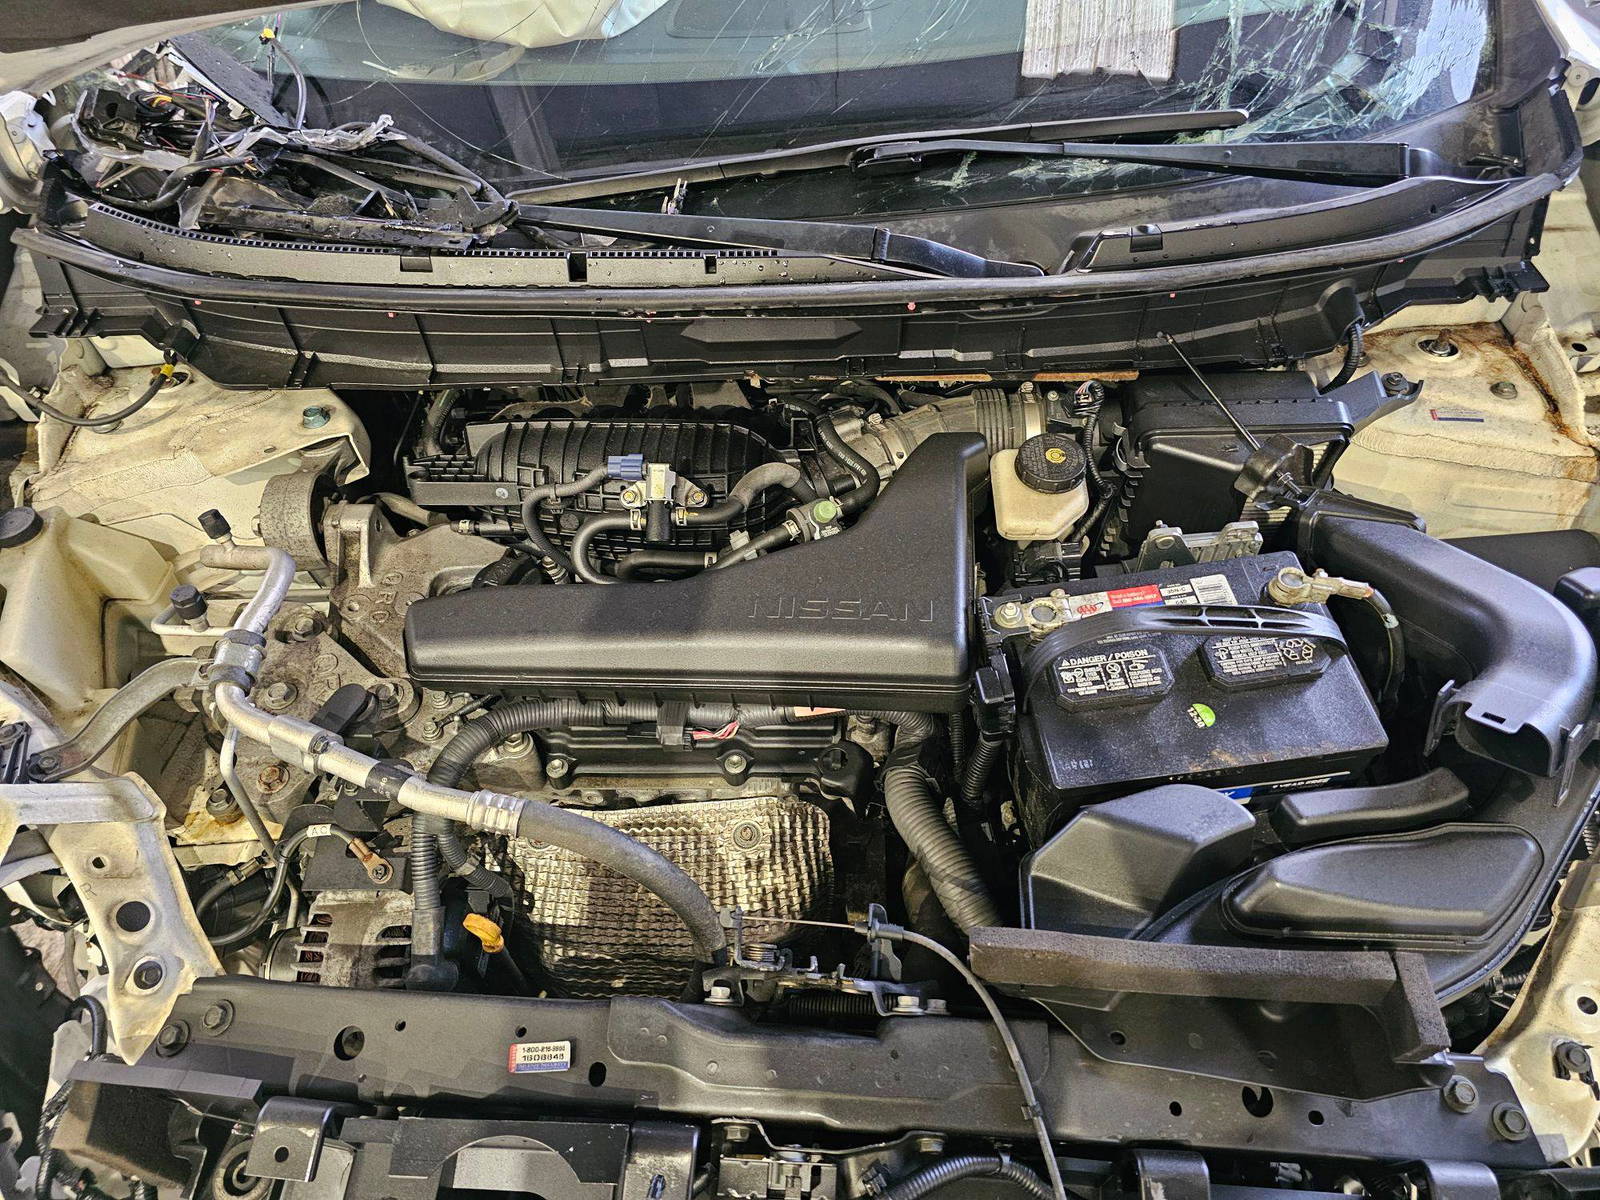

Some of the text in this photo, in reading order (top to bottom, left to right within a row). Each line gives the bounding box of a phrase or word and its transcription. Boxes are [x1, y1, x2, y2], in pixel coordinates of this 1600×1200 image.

[748, 595, 933, 622] NISSAN
[1069, 654, 1107, 666] DANGER
[1114, 649, 1149, 660] POISON
